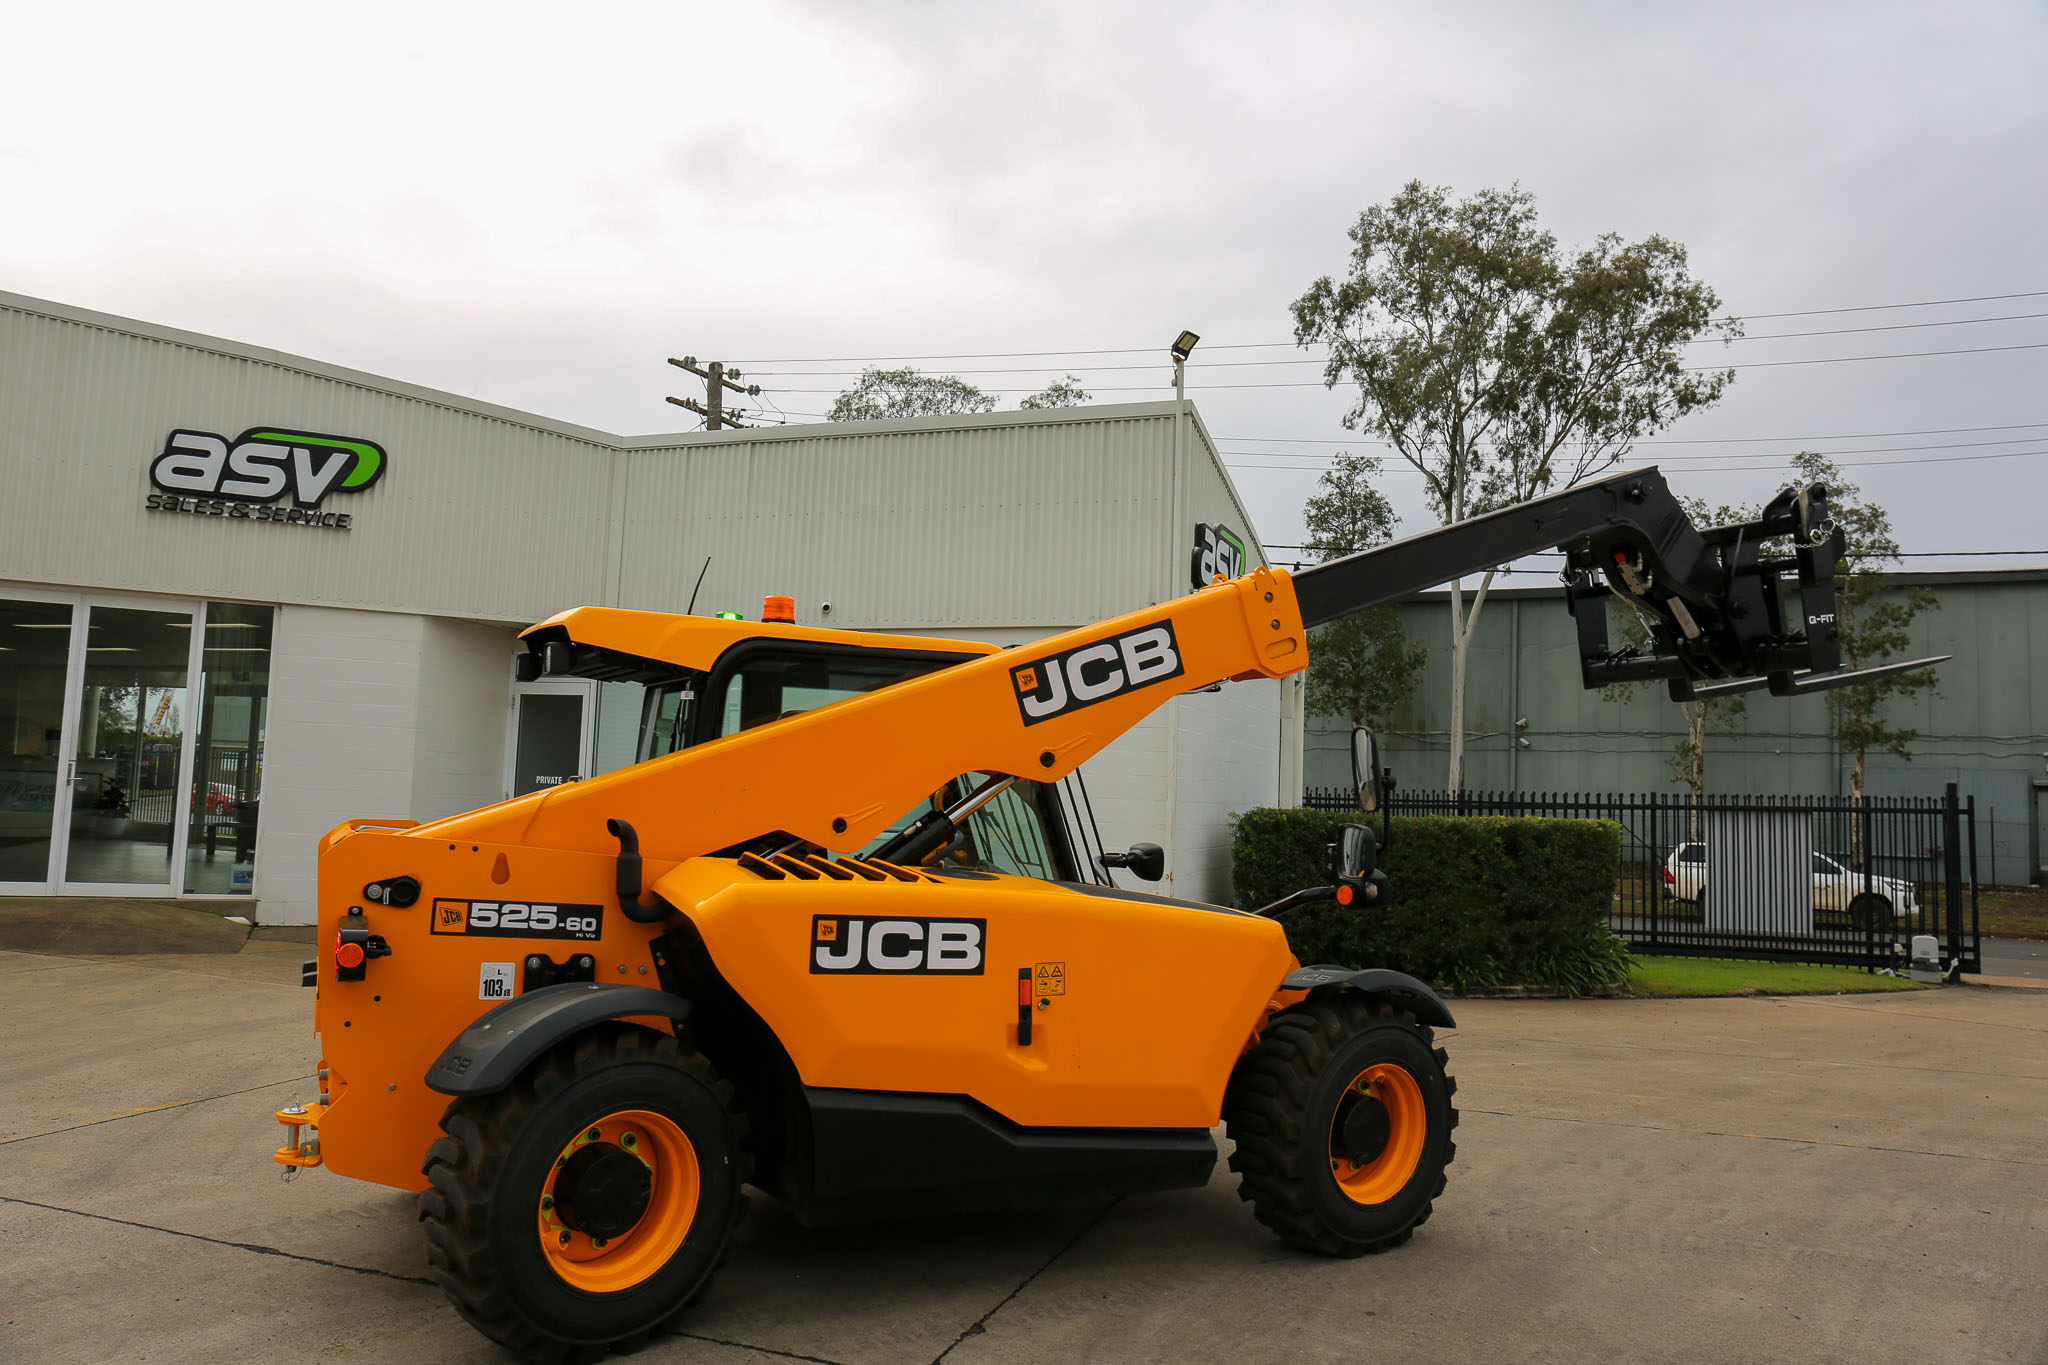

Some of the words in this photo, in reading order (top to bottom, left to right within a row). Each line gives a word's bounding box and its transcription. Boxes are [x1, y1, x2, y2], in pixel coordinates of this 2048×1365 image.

[154, 433, 351, 503] asv
[229, 503, 251, 518] &
[256, 506, 352, 529] SERVICE
[1808, 613, 1834, 624] Q-FIT
[1022, 627, 1178, 718] JCB
[536, 776, 563, 784] PRIVATE
[442, 910, 462, 925] JCB
[469, 902, 597, 932] 525-60
[815, 920, 981, 970] JCB
[497, 968, 503, 976] L
[483, 978, 504, 997] 103
